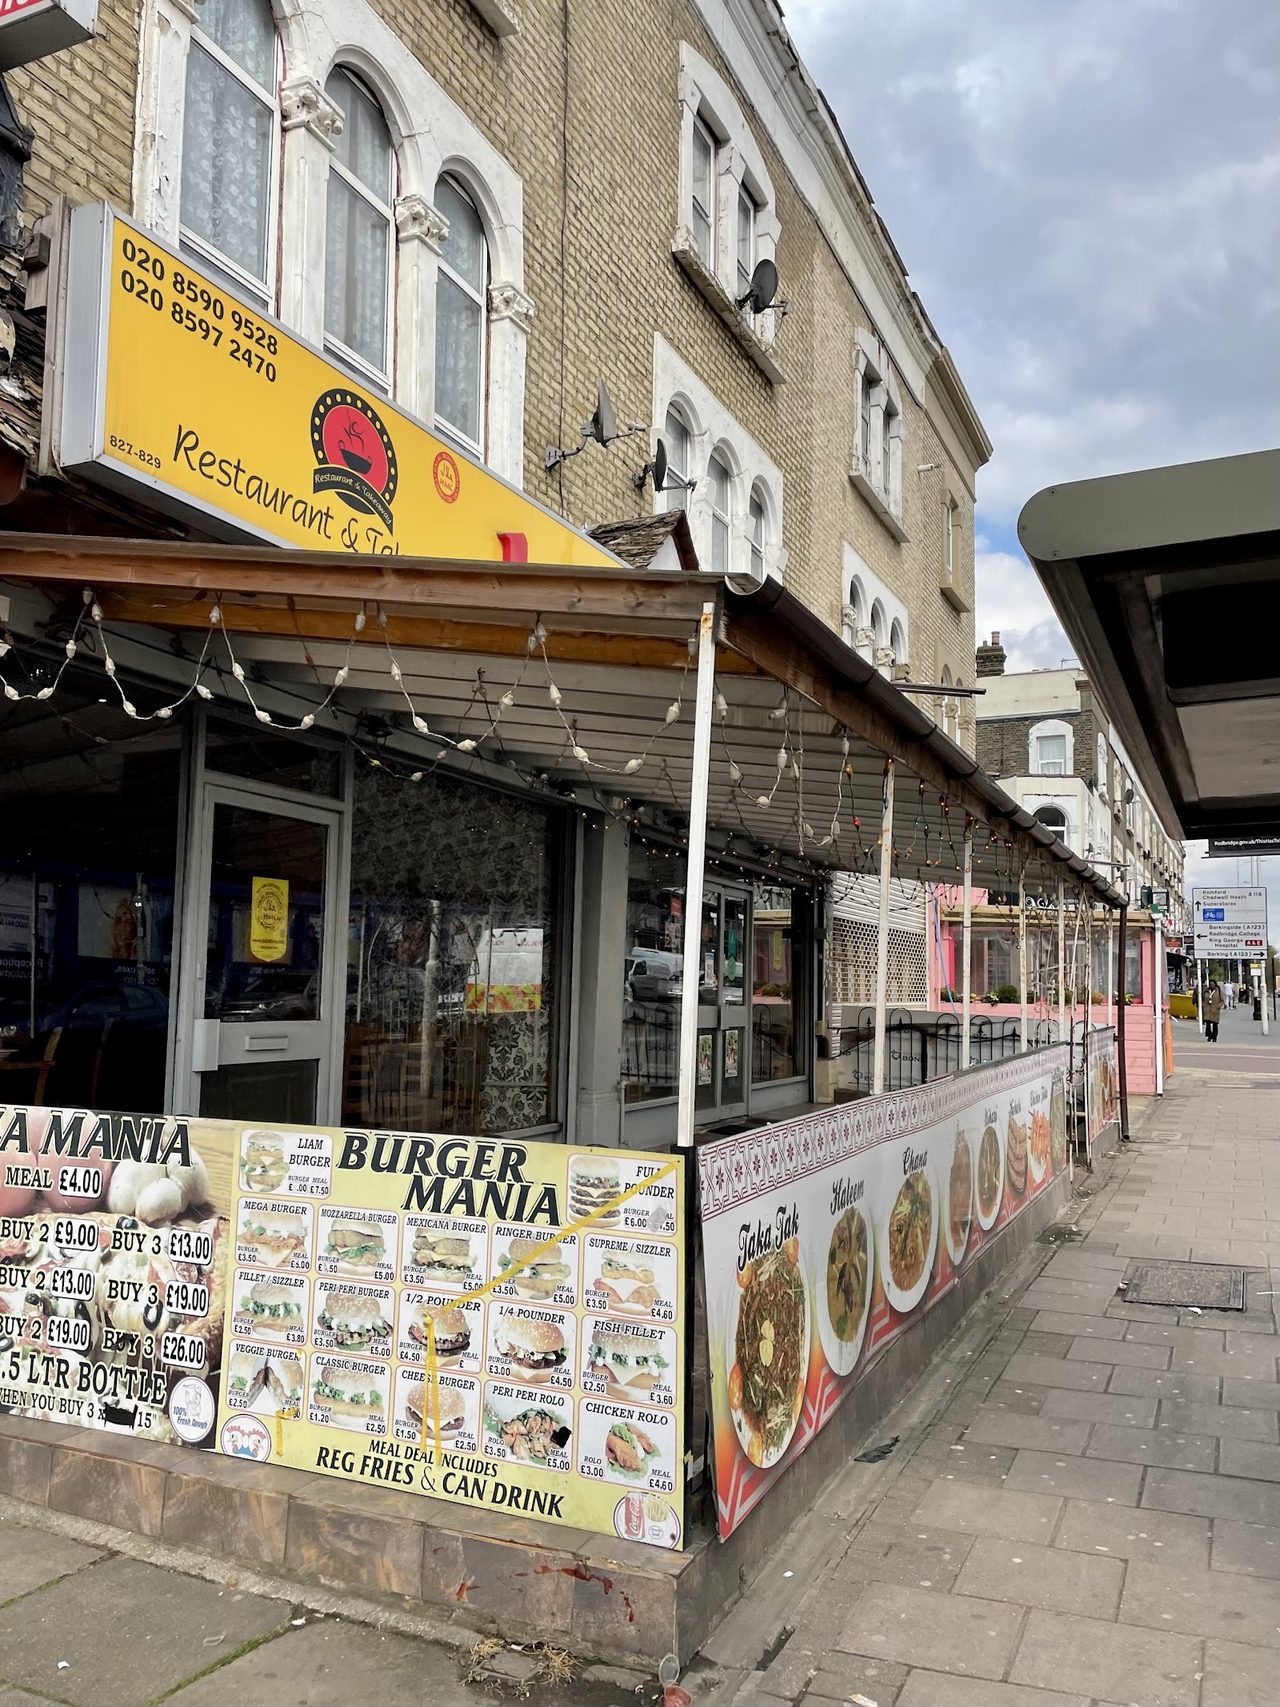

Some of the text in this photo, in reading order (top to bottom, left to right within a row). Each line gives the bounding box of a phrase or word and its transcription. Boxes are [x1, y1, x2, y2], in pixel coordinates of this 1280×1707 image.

[123, 238, 277, 355] 020 8590 9528
[121, 270, 276, 382] 020 8597 2470
[110, 434, 161, 468] 827-829
[173, 425, 359, 552] Restaurant &
[315, 474, 353, 486] Restaurant
[362, 486, 391, 524] Takeaway
[40, 1110, 192, 1167] MANIA
[298, 1138, 323, 1150] LIAM
[289, 1154, 331, 1168] BURGER
[335, 1130, 534, 1184] BURGER
[903, 1146, 928, 1176] Chana
[6, 1167, 100, 1193] MEAL £4.00
[288, 1175, 310, 1183] BURGER
[310, 1186, 329, 1195] £7.50
[830, 1177, 865, 1215] Haleem
[401, 1175, 562, 1227] MANIA
[244, 1201, 307, 1215] MEGA BURGER
[623, 1208, 650, 1216] BURGER
[321, 1209, 397, 1224] MOZZARELLA BURGER
[625, 1216, 647, 1228] £6.00
[406, 1217, 486, 1233] MEXICANA BURGER
[1, 1220, 96, 1246] BUY 2 £9.00
[495, 1227, 532, 1239] RINGER
[737, 1202, 799, 1272] Taka Tak
[112, 1231, 209, 1259] BUY 3 £13.00
[589, 1238, 628, 1252] SUPREME
[636, 1244, 671, 1257] SIZZLER
[0, 1267, 91, 1295] BUY 2 £13.00
[238, 1272, 305, 1288] FILLET SIZZLER
[374, 1271, 394, 1281] £5.00
[404, 1274, 424, 1284] £3.50
[319, 1282, 390, 1299] PERI PERI BURGER
[556, 1285, 574, 1293] MEAL
[585, 1289, 610, 1299] BURGER
[108, 1280, 206, 1312] BUY 3 £19.00
[406, 1293, 423, 1306] 1/2
[554, 1294, 575, 1304] £5.00
[586, 1298, 607, 1310] £3.50
[654, 1299, 673, 1308] MEAL
[499, 1306, 565, 1325] 1/4 POUNDER
[651, 1308, 673, 1320] £4.60
[32, 1320, 42, 1339] 2
[48, 1320, 87, 1346] £19.00
[234, 1325, 252, 1335] £2.50
[593, 1320, 665, 1340] FISH FILLET
[103, 1330, 203, 1364] BUY 3 £26.00
[236, 1343, 265, 1355] VEGGIE
[314, 1338, 334, 1348] £3.50
[370, 1346, 391, 1357] £5.00
[400, 1351, 420, 1362] £4.50
[461, 1351, 479, 1360] MEAL
[316, 1356, 386, 1375] CLASSIC BURGER
[489, 1365, 511, 1376] £3.00
[553, 1367, 571, 1375] MEAL
[27, 1354, 166, 1405] LTR BOTTLE
[551, 1376, 572, 1387] £4.50
[582, 1371, 609, 1382] BURGER
[439, 1376, 475, 1390] BURGER
[584, 1381, 605, 1393] £2.50
[652, 1383, 672, 1393] MEAL
[492, 1385, 565, 1407] PERI PERI ROLO
[650, 1392, 673, 1405] £3.60
[31, 1392, 94, 1418] YOU BUY 3
[229, 1398, 248, 1408] £2.50
[173, 1407, 187, 1416] 100%
[586, 1402, 668, 1425] CHICKEN ROLO
[192, 1418, 208, 1429] Dough
[310, 1413, 329, 1423] £1.20
[366, 1423, 386, 1434] £2.50
[396, 1428, 416, 1440] £1.50
[457, 1431, 474, 1439] MEAL
[488, 1437, 504, 1445] ROLO
[369, 1439, 401, 1458] MEAL
[455, 1440, 476, 1451] £2.50
[484, 1446, 506, 1458] £3.50
[550, 1449, 568, 1458] MEAL
[547, 1458, 570, 1470] £5.00
[584, 1456, 602, 1465] ROLO
[581, 1465, 603, 1478] £3.00
[651, 1469, 672, 1478] MEAL
[316, 1446, 565, 1518] REG FRIES & CAN DRINK
[649, 1478, 673, 1491] £4.60
